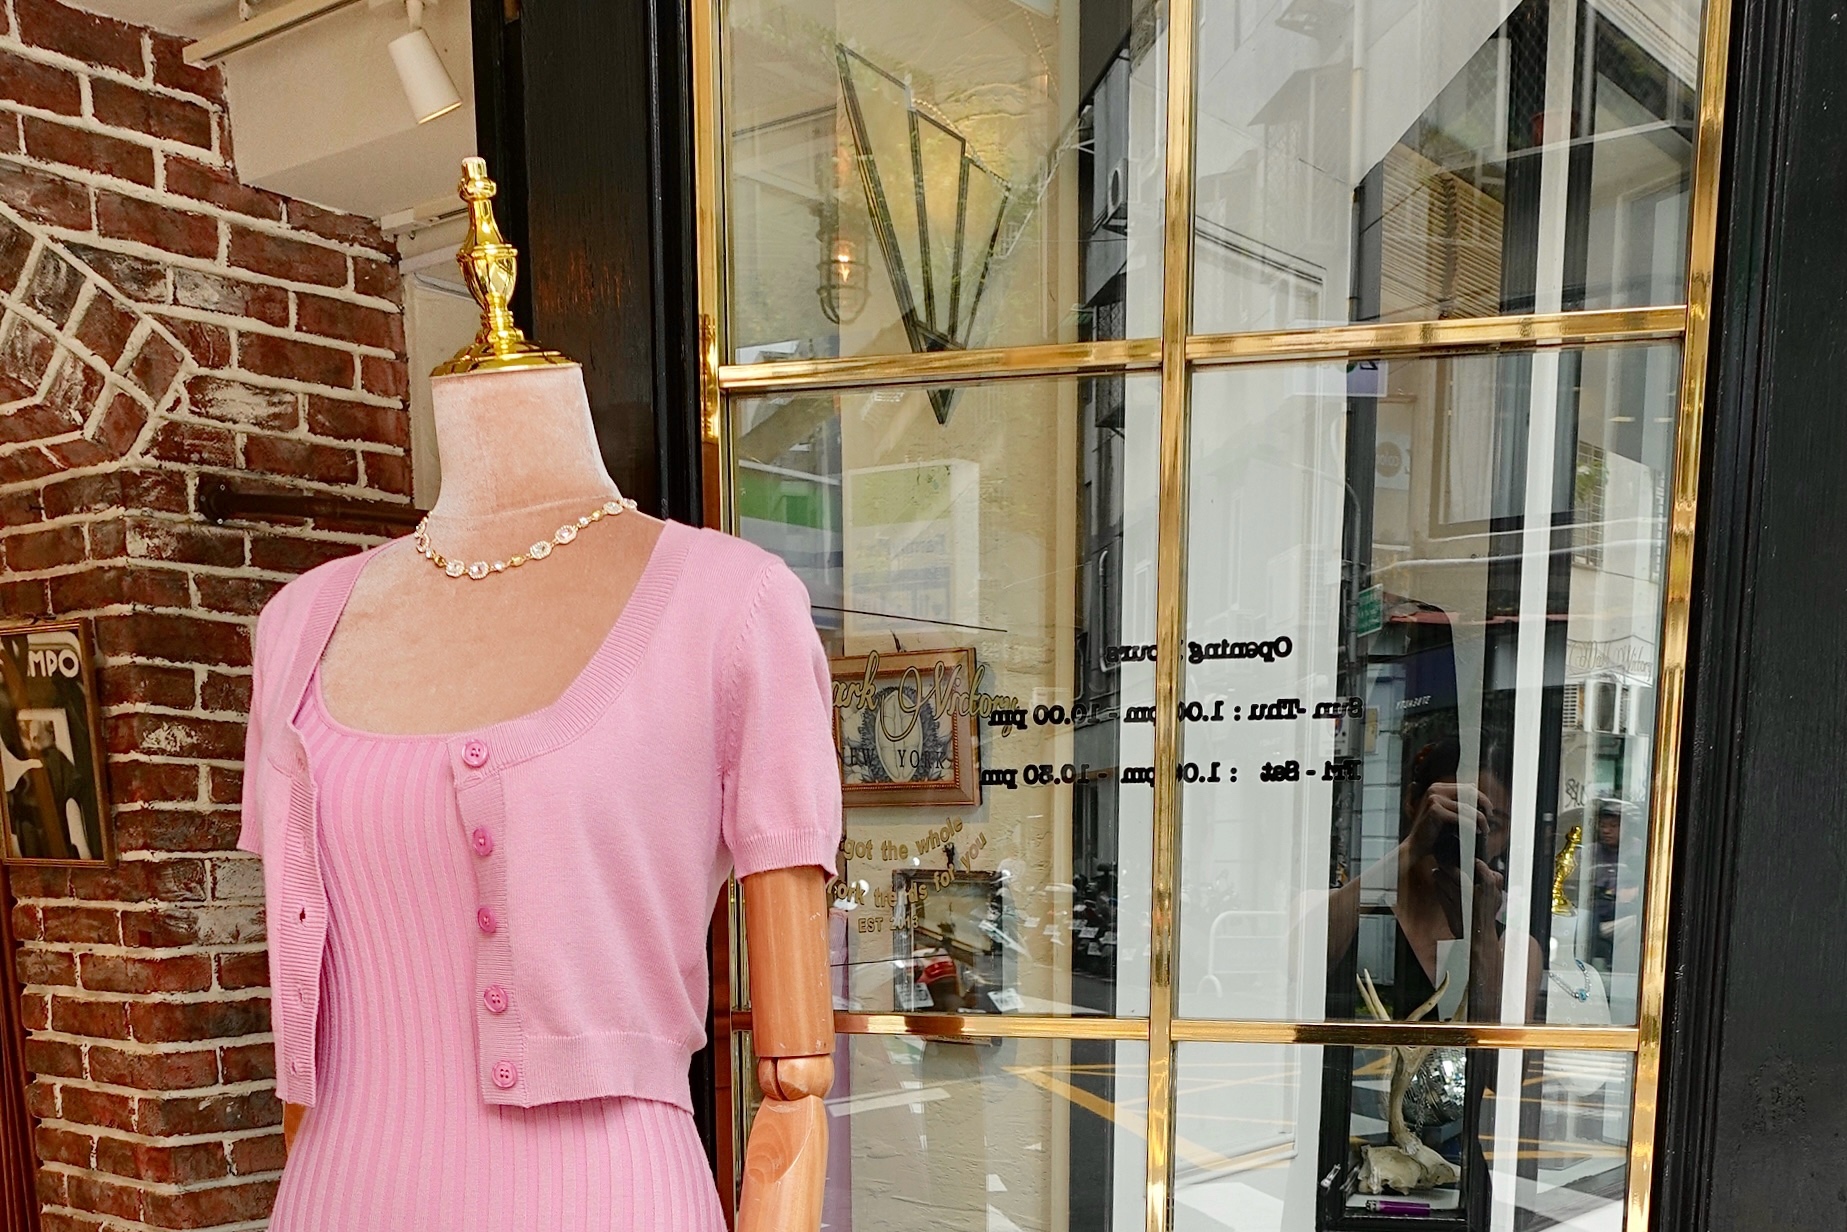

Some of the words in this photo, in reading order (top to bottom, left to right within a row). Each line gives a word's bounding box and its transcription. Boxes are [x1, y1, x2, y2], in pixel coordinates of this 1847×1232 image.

[27, 648, 80, 678] MPO
[832, 649, 879, 712] ark
[843, 745, 877, 767] EW
[897, 748, 945, 770] YORK
[843, 837, 874, 861] got
[880, 839, 909, 862] the
[914, 815, 964, 856] whole
[933, 863, 956, 893] for
[959, 831, 988, 874] you
[857, 916, 884, 934] EST
[889, 915, 920, 931] 2013
